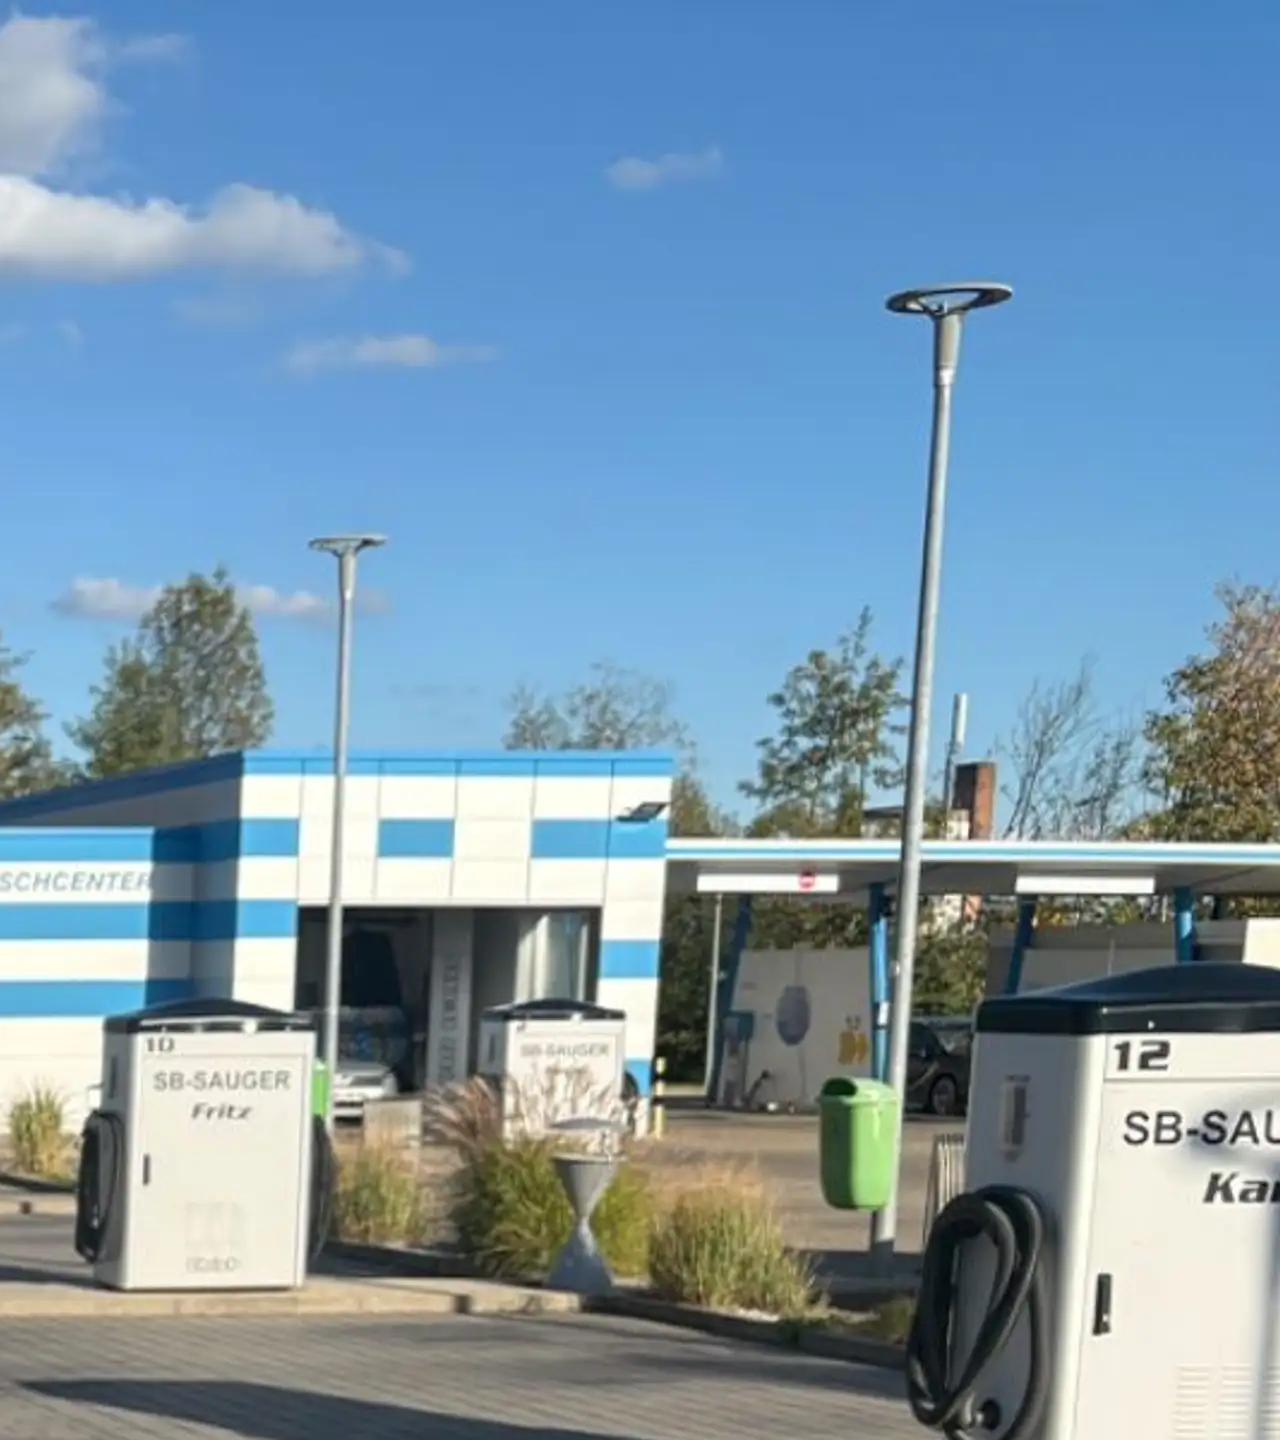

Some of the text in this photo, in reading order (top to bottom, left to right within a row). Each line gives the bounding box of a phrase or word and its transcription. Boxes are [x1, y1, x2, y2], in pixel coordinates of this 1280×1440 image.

[1114, 1040, 1171, 1072] 12
[153, 1070, 292, 1091] SB-SAUGER
[191, 1102, 253, 1120] Fritz
